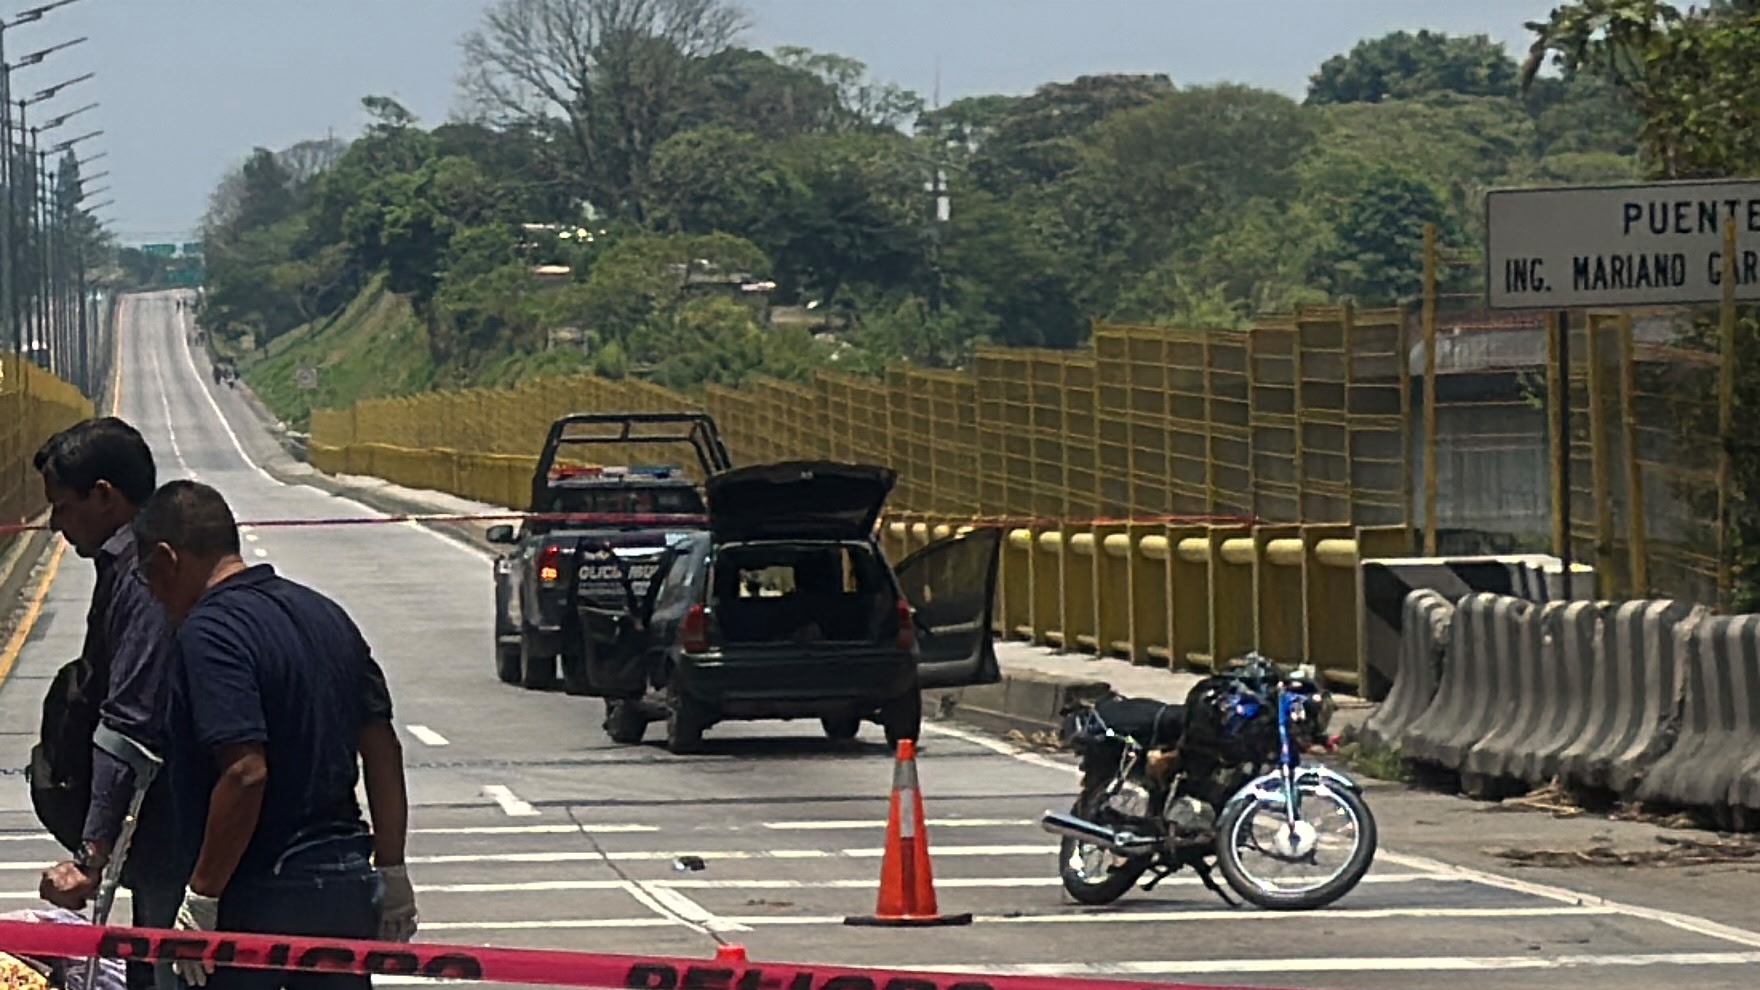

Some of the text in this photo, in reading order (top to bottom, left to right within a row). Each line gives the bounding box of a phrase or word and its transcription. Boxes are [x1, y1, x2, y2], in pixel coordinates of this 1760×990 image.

[1623, 199, 1760, 235] PUENTE
[1505, 257, 1552, 293] ING.
[1572, 253, 1686, 291] MARIANO
[97, 930, 483, 981] PELIGRO
